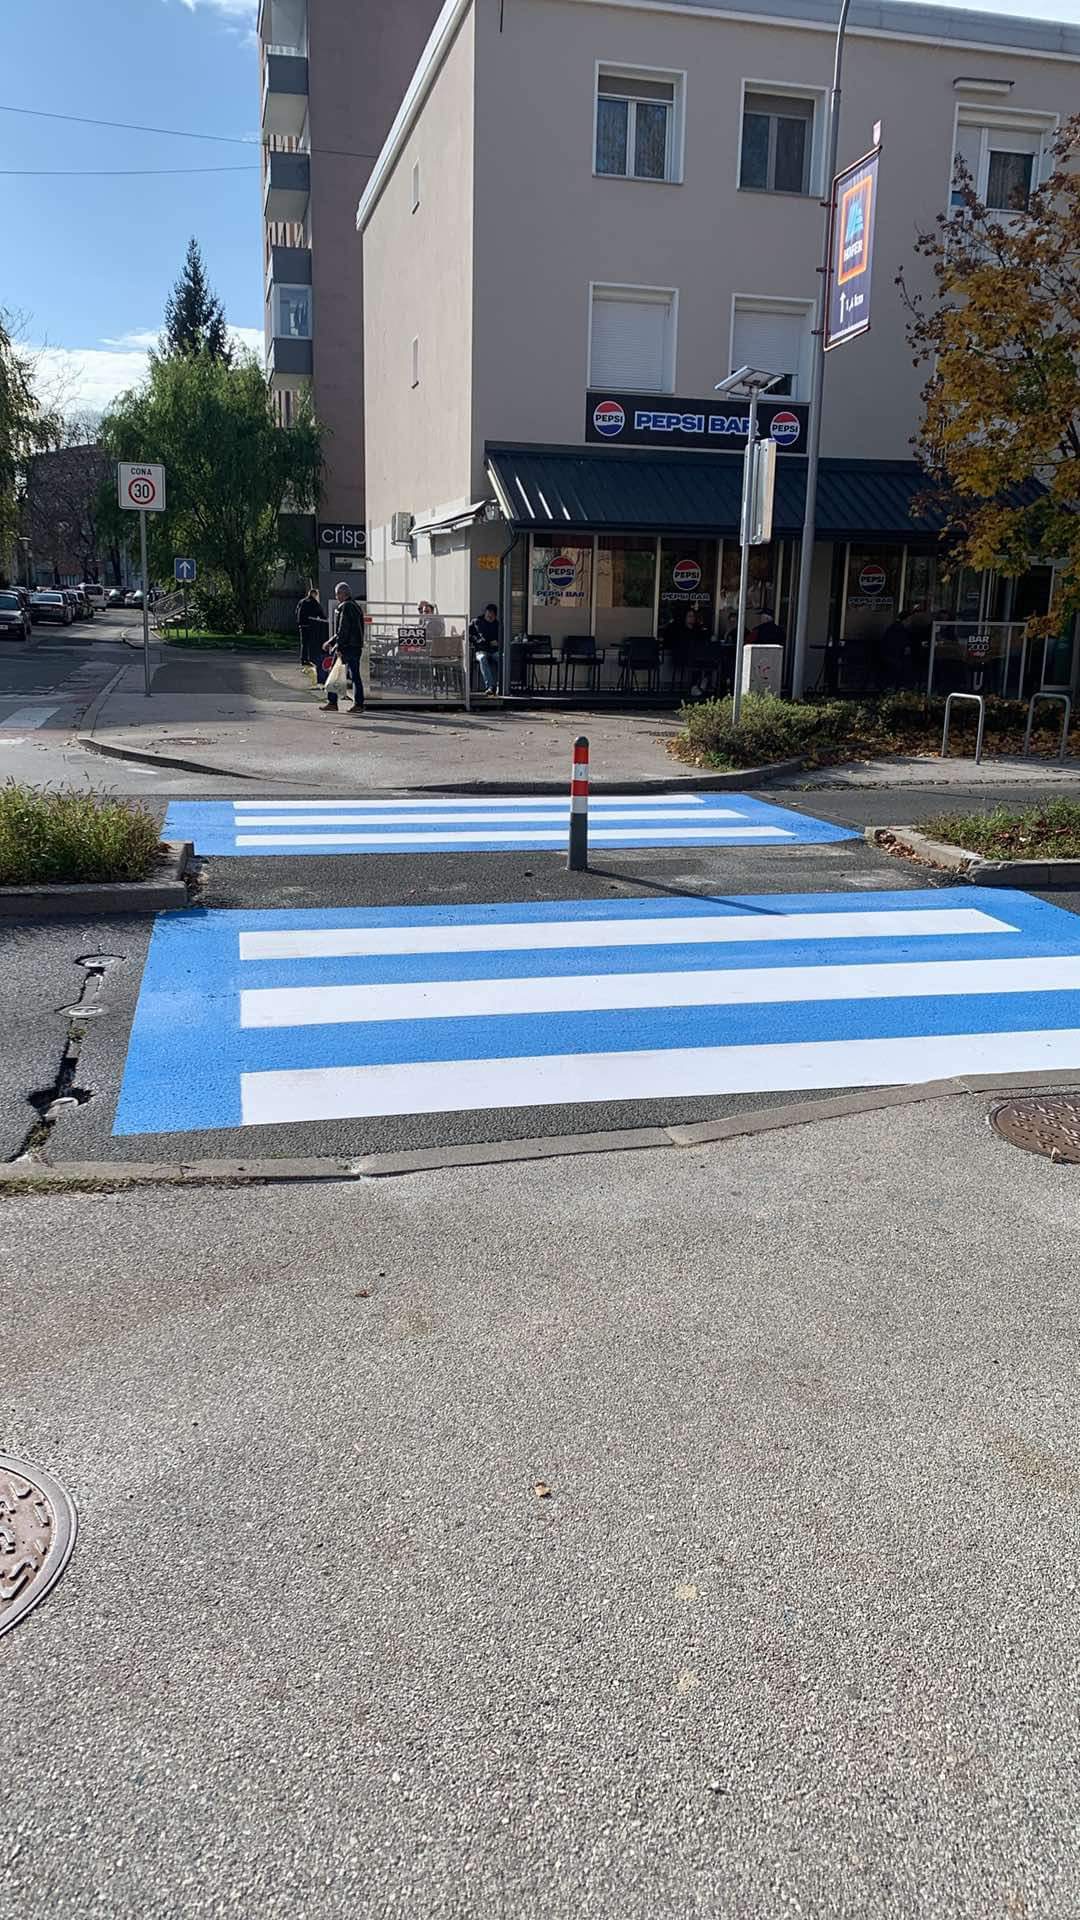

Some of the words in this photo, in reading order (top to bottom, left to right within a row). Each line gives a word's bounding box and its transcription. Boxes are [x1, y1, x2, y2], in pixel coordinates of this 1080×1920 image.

[844, 239, 863, 262] HOFER
[595, 415, 624, 423] PEPSI
[634, 411, 705, 433] PEPSI
[708, 415, 761, 437] BAR
[772, 425, 798, 433] PEPSI
[134, 483, 150, 499] 30
[321, 525, 367, 549] crisp
[548, 568, 575, 576] PEPSI
[536, 590, 563, 598] PEPSI
[565, 591, 585, 599] BAR
[399, 629, 425, 638] BAR
[399, 638, 426, 646] 2000
[968, 635, 990, 643] BAR
